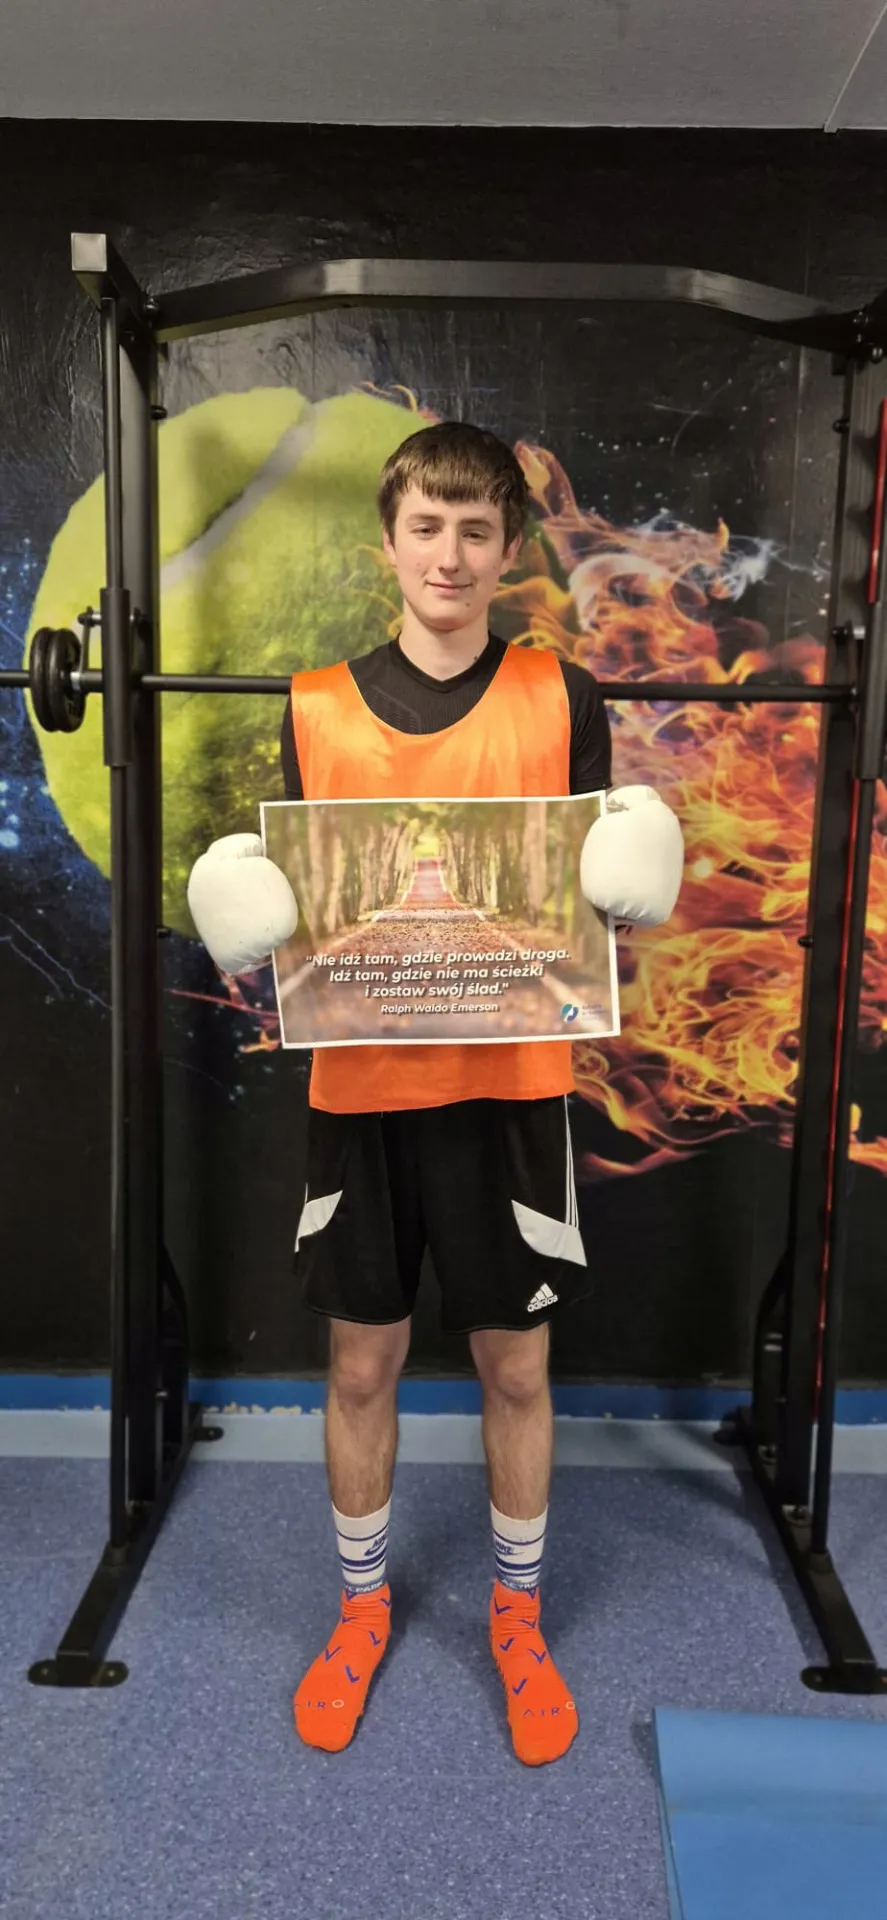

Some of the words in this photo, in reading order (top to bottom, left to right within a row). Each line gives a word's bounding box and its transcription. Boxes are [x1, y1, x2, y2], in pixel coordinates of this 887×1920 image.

[306, 954, 336, 966] "Nie
[340, 952, 361, 965] idź
[365, 953, 398, 966] tam,
[402, 951, 443, 966] gdzie
[447, 949, 517, 965] prowadzi
[521, 947, 570, 962] droga.
[330, 969, 351, 982] Idź
[355, 970, 388, 982] tam,
[392, 967, 432, 983] gdzie
[436, 966, 460, 979] nie
[463, 968, 489, 979] ma
[492, 964, 544, 978] ścieżki
[365, 984, 370, 997] i
[373, 985, 425, 997] zostaw
[428, 982, 464, 997] swój
[467, 981, 509, 995] ślad."
[381, 1003, 411, 1015] Ralph
[414, 1003, 448, 1013] Waldo
[451, 1002, 499, 1012] Emerson
[527, 1294, 558, 1312] adidas
